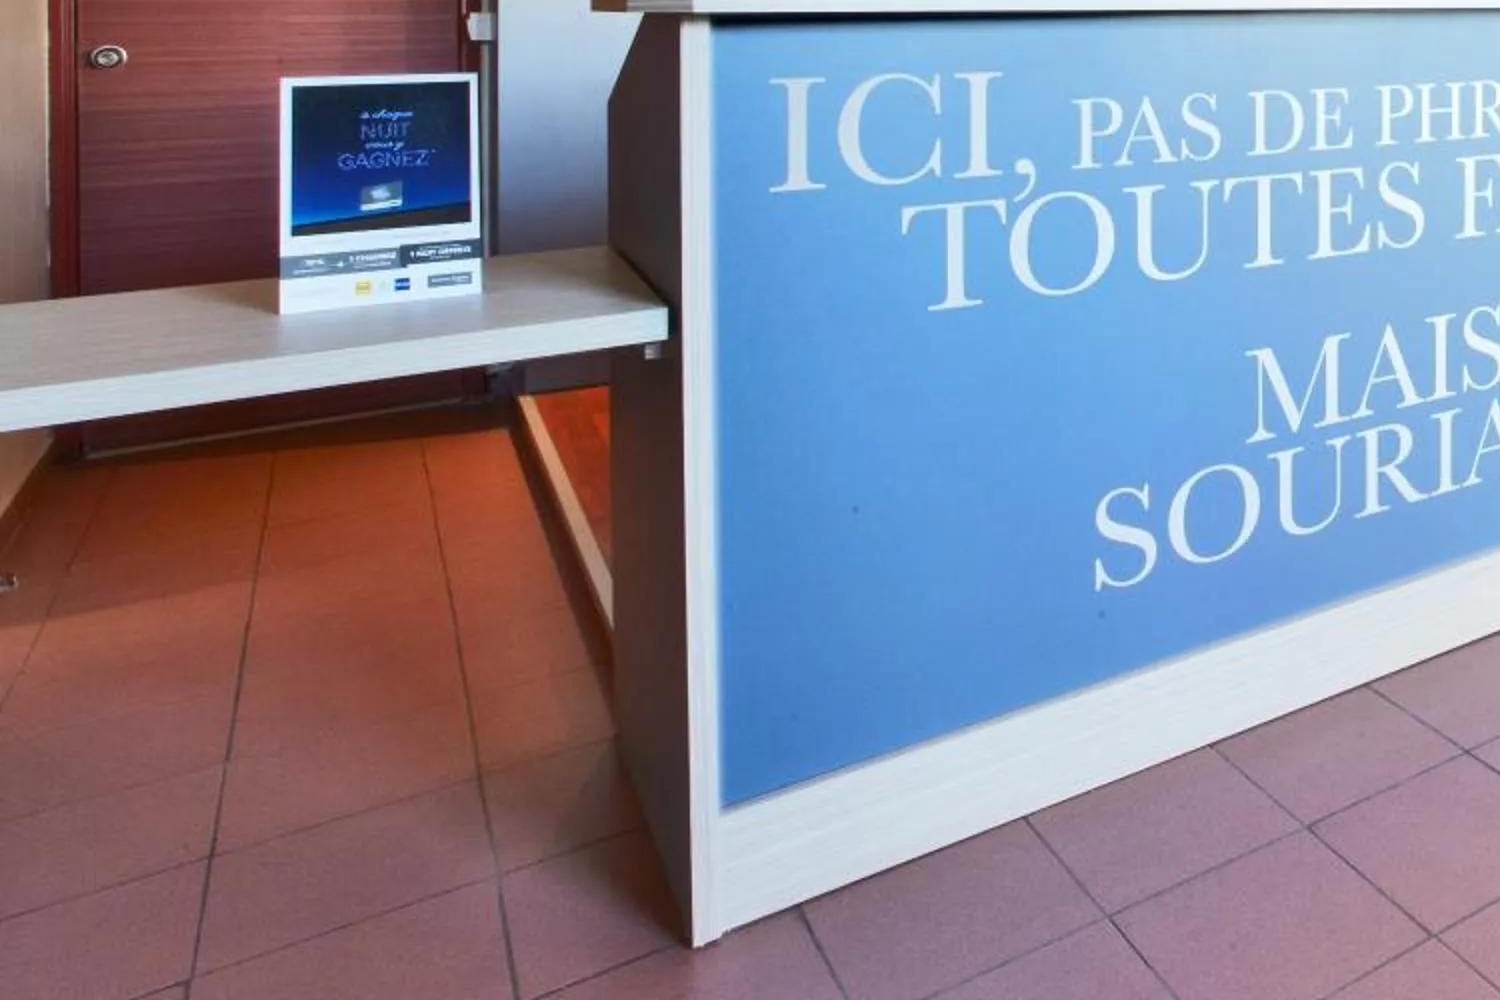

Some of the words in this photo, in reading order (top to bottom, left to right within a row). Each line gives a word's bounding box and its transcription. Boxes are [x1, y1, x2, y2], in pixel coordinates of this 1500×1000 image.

[360, 121, 412, 140] NUIT
[768, 70, 1038, 202] ICI,
[1071, 91, 1222, 170] PAS
[1246, 87, 1354, 156] DE
[901, 161, 1426, 312] TOUTES
